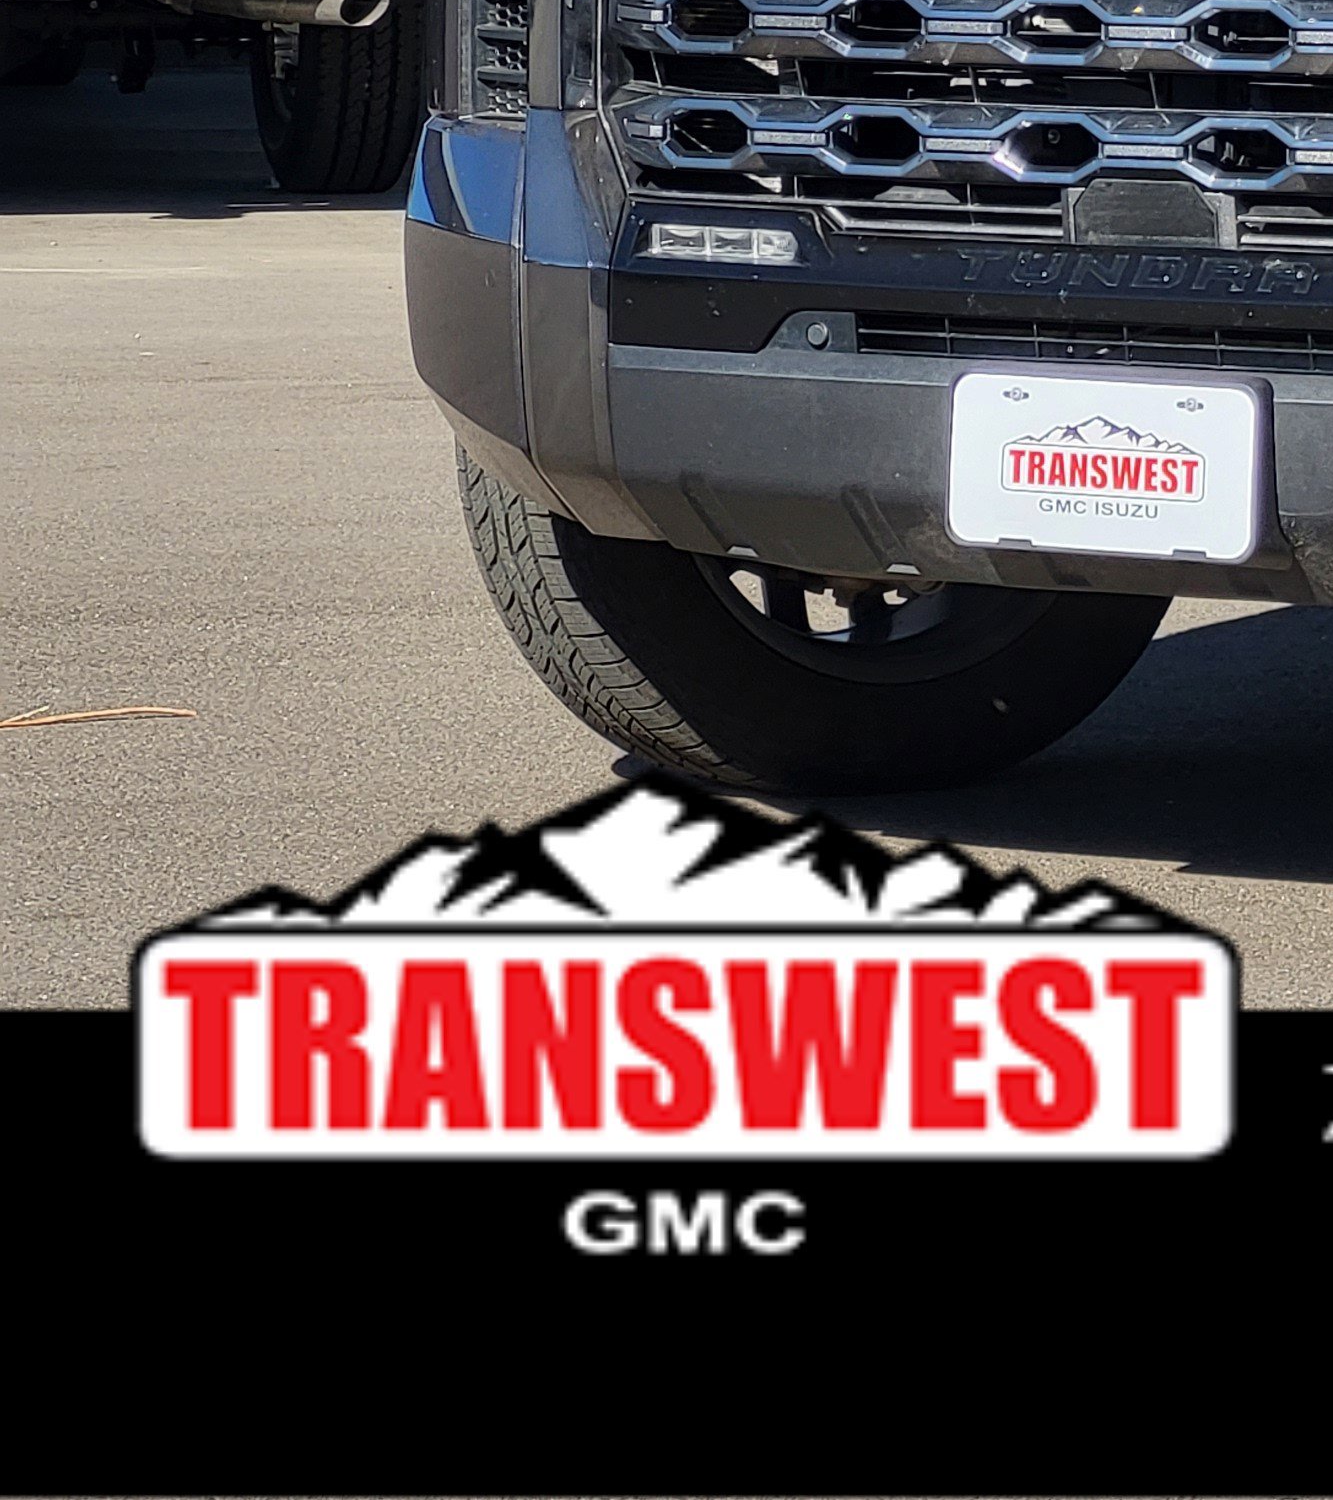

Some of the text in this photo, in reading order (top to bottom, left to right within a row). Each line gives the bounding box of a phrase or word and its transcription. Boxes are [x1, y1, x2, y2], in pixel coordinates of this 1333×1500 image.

[959, 249, 1318, 295] TUNDRA
[1009, 449, 1199, 495] TRANSWEST
[1039, 498, 1159, 519] GMC ISUZU
